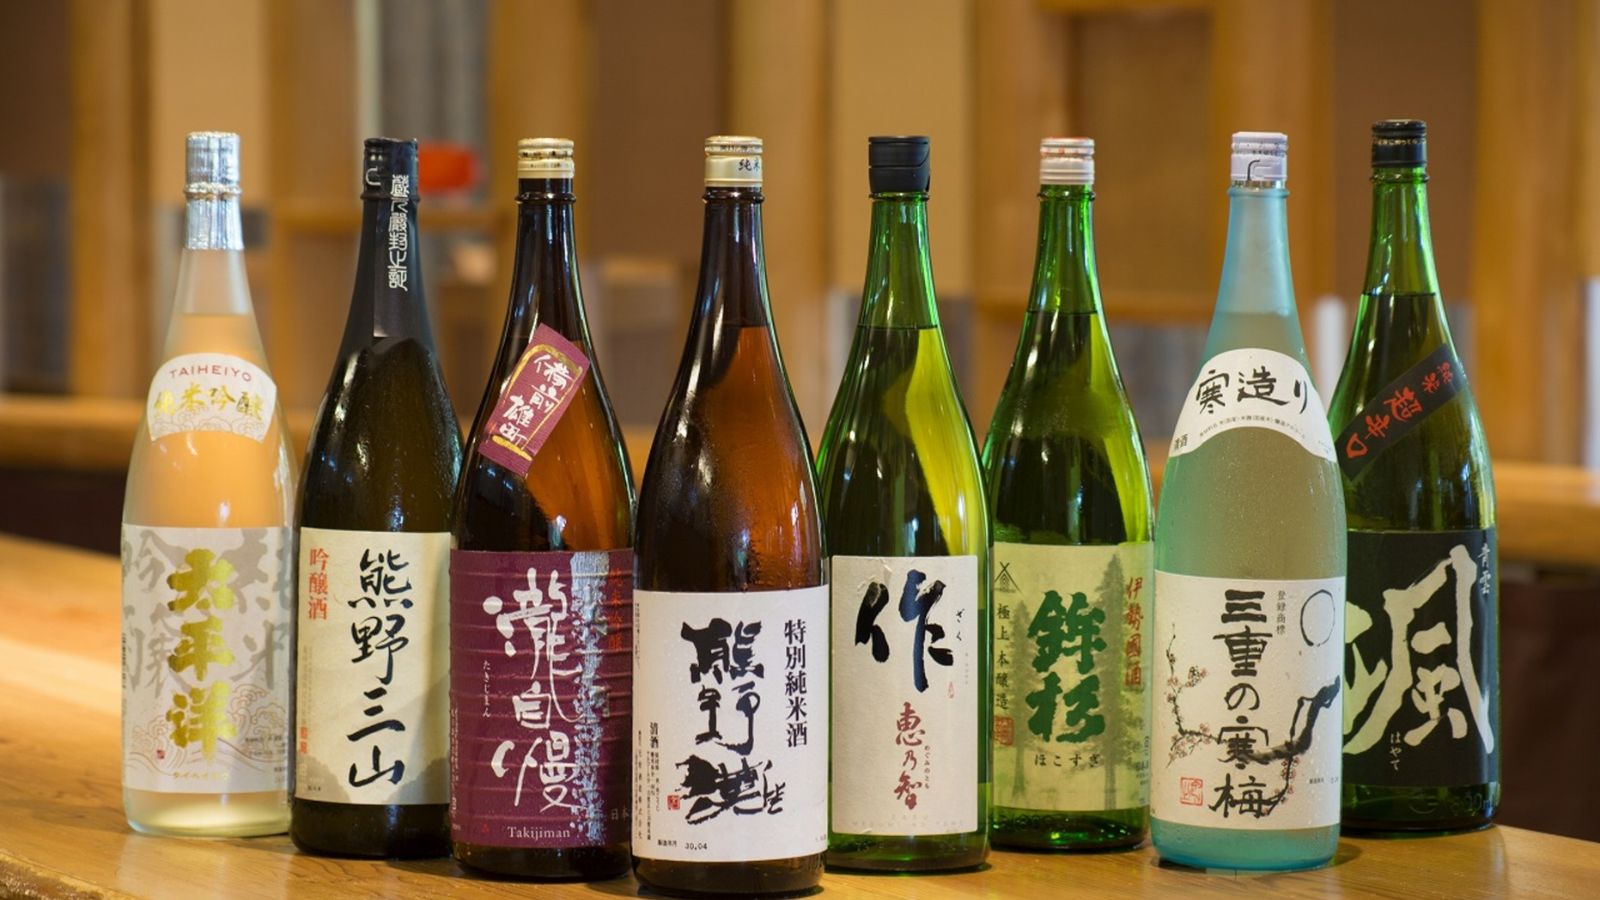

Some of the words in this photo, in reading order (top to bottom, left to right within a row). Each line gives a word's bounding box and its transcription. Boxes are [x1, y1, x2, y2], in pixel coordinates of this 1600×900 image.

[169, 364, 252, 383] TAIHEIYO
[1195, 366, 1308, 415] 寒造り
[308, 548, 330, 621] 吟醸酒
[166, 547, 238, 766] 太平洋
[346, 548, 414, 788] 熊野三山
[854, 569, 954, 694] 作
[1025, 590, 1107, 743] 鉾杉
[784, 618, 808, 748] 特別純米酒
[1208, 588, 1274, 819] 三重の寒梅
[649, 721, 659, 749] 清酒
[893, 701, 926, 810] 恵乃智
[1034, 754, 1101, 768] ほこすぎ
[1390, 731, 1402, 771] はやて
[507, 826, 571, 841] Takijiman
[684, 842, 708, 850] 30.04
